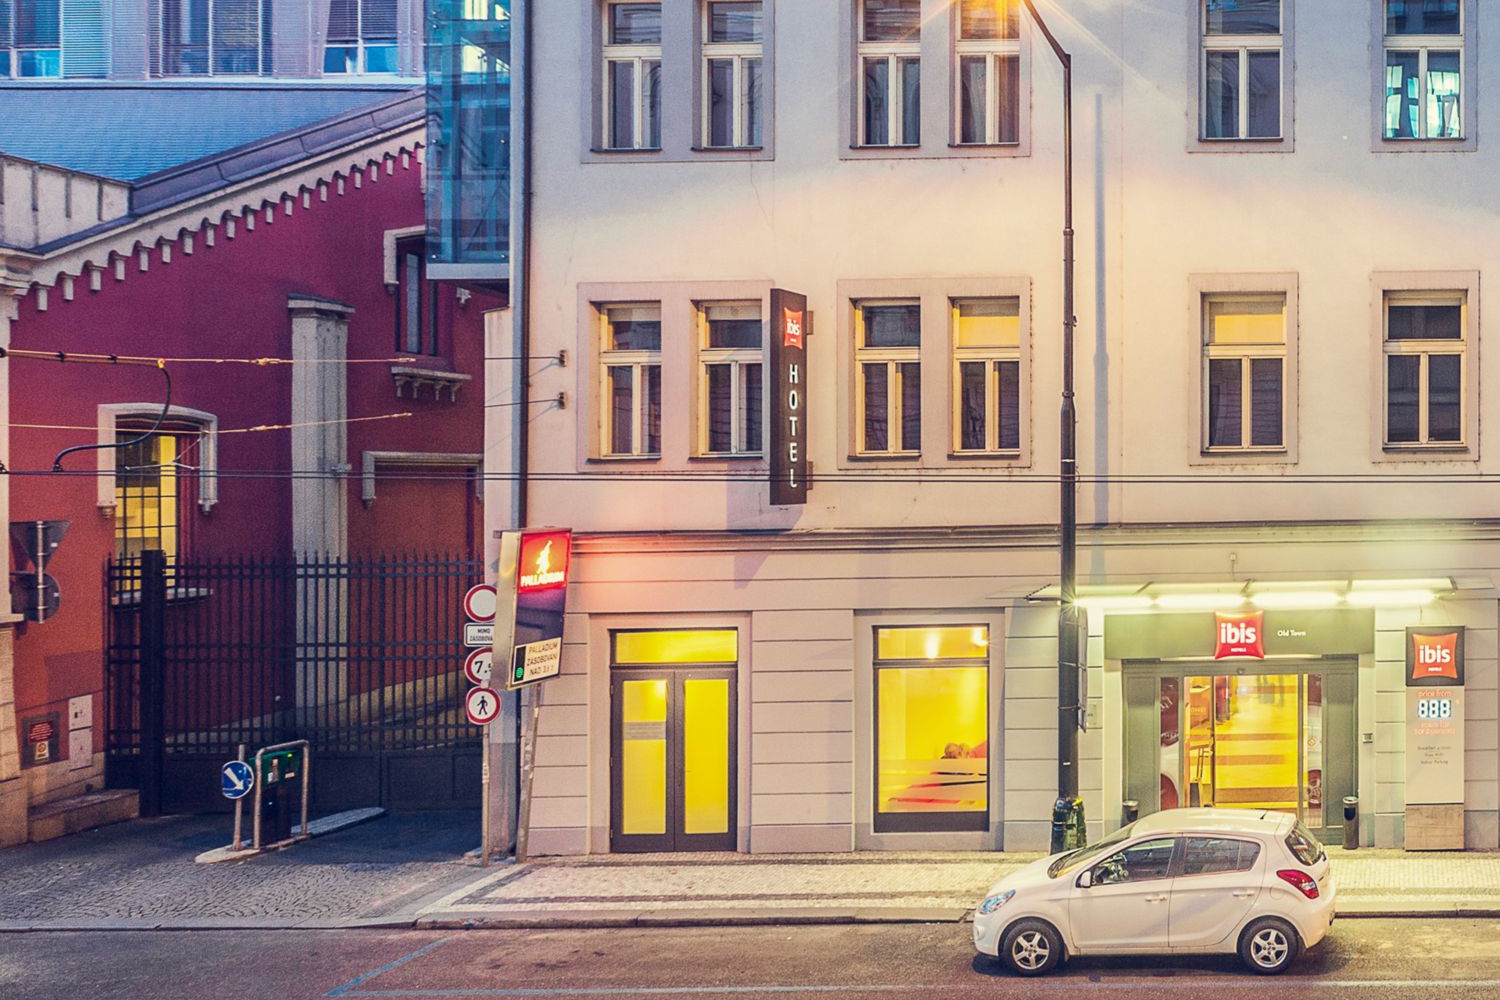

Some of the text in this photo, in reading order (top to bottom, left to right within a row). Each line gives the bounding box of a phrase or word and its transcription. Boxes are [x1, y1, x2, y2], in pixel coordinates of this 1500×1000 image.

[786, 318, 800, 336] ibis
[788, 363, 799, 489] HOTEL
[1220, 622, 1257, 644] ibis
[1277, 629, 1307, 637] Old Town
[1418, 645, 1452, 664] ibis
[1418, 699, 1451, 718] 888
